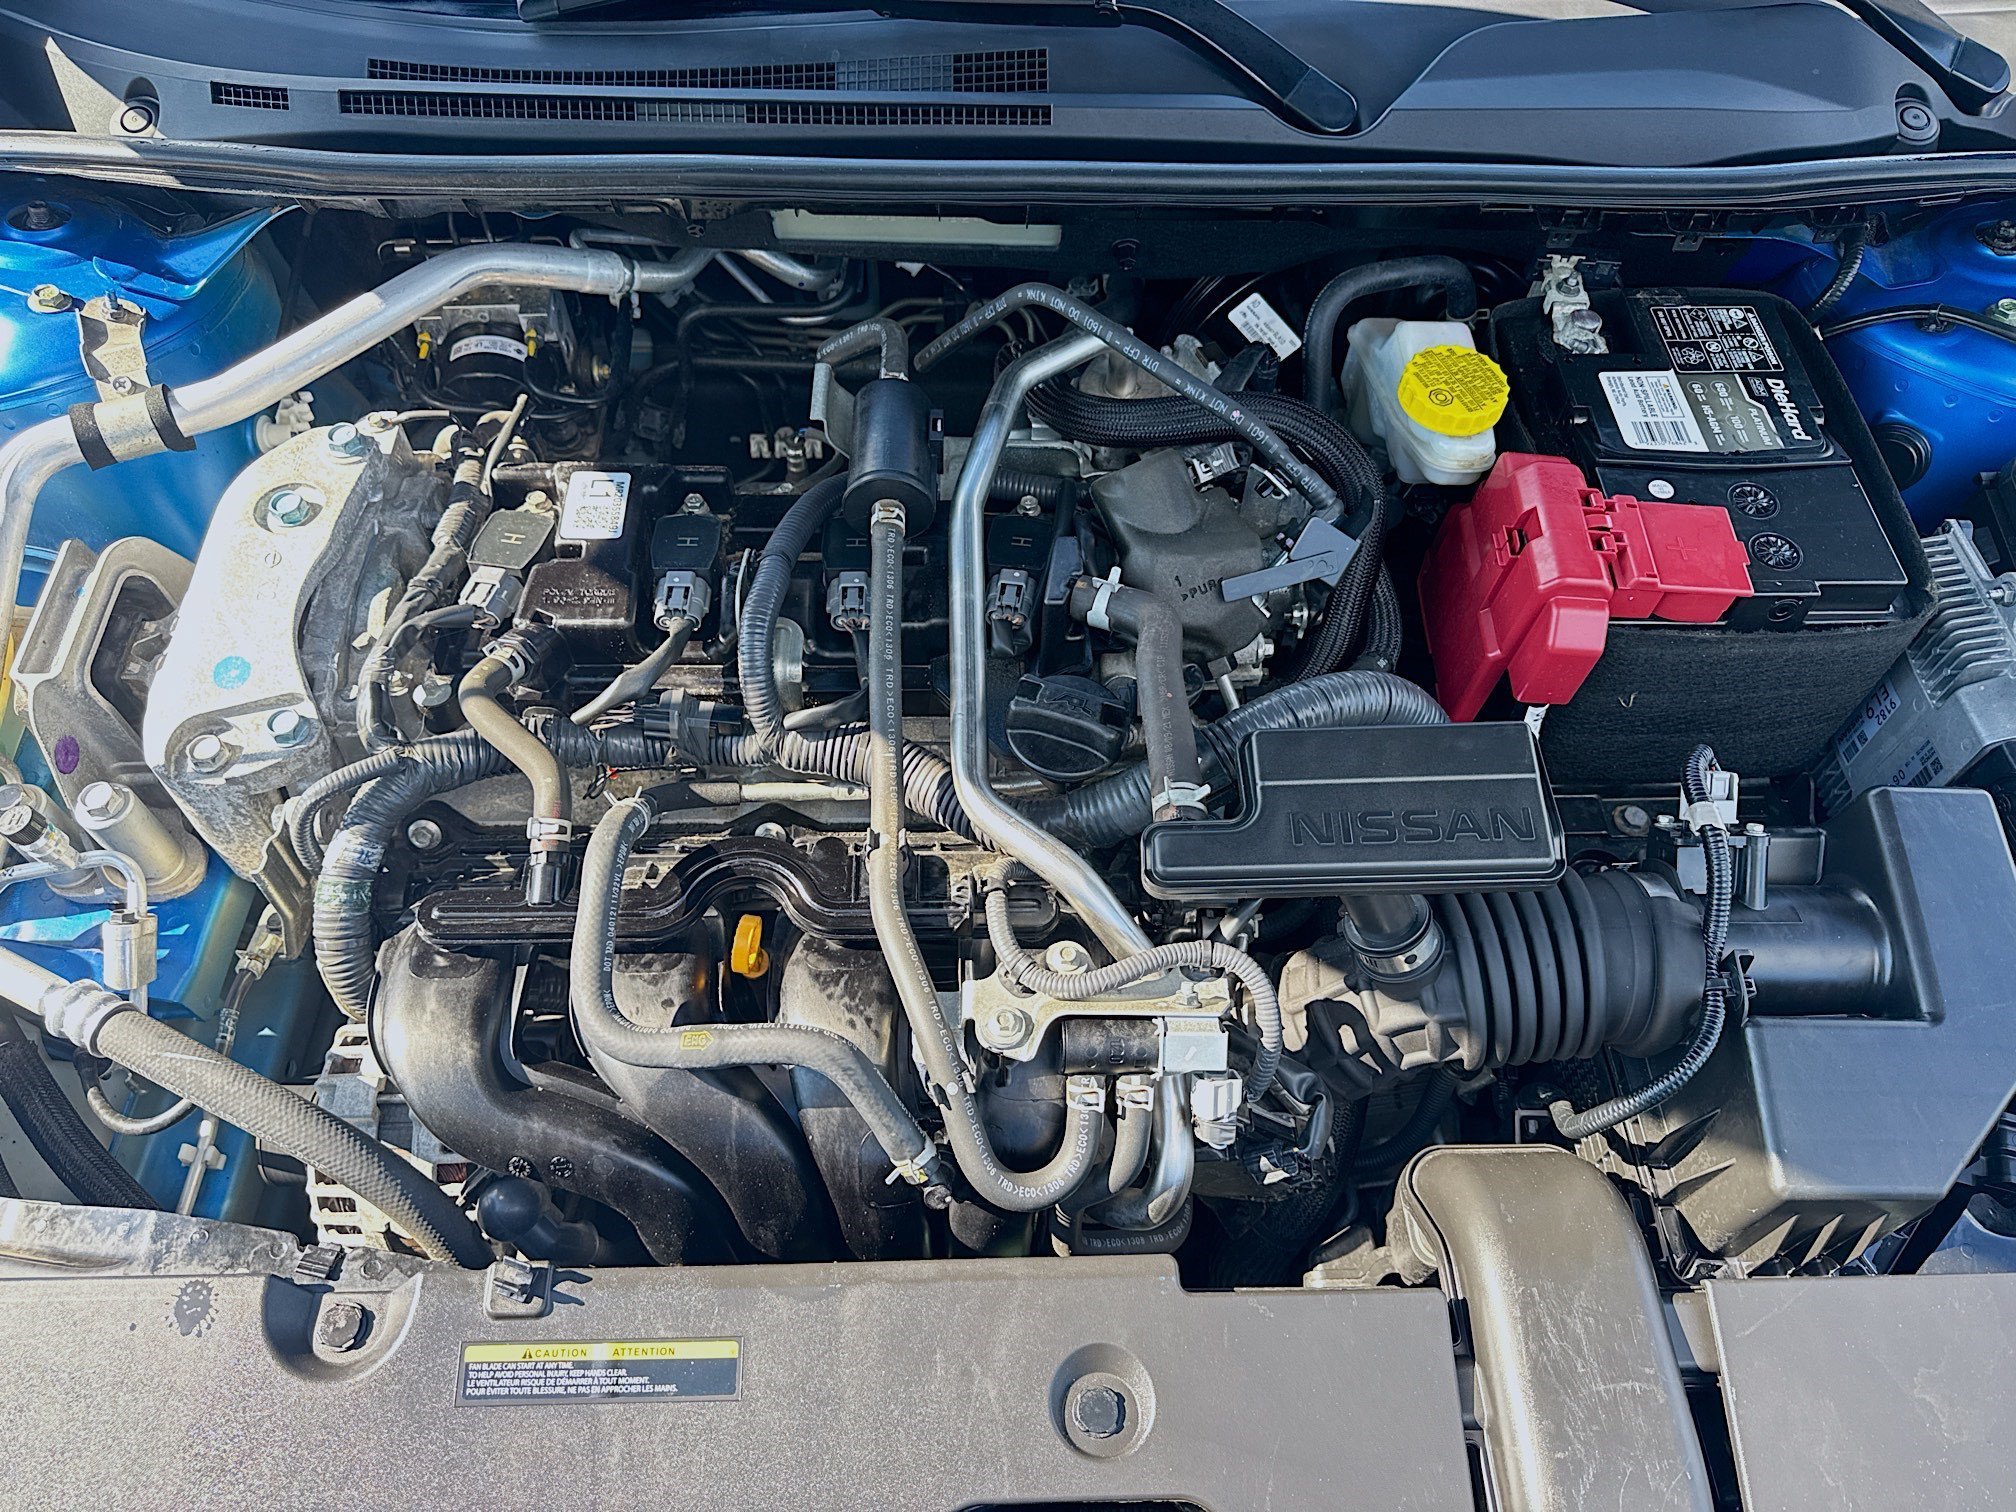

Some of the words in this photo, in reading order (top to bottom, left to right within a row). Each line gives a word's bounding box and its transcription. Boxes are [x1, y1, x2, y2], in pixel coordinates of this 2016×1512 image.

[1050, 296, 1066, 312] NOT
[1069, 306, 1080, 321] DO
[1084, 316, 1102, 334] 1601
[1122, 345, 1140, 360] CFP
[1142, 356, 1160, 372] DTR
[1210, 396, 1230, 415] NOT
[1766, 378, 1812, 441] DieHard
[1230, 410, 1244, 426] DO
[1730, 416, 1744, 430] 100
[1749, 408, 1773, 446] PLATINUM
[1247, 422, 1269, 444] 1601
[1285, 462, 1303, 476] CFP
[1301, 475, 1321, 493] DTR
[1875, 698, 1896, 726] 9182
[1289, 806, 1536, 846] NISSAN
[607, 906, 617, 937] 040121
[603, 957, 612, 971] DOT
[1064, 1112, 1090, 1178] TRD>ECO<13
[535, 1349, 587, 1357] CAUTION
[613, 1347, 675, 1356] ATTENTION
